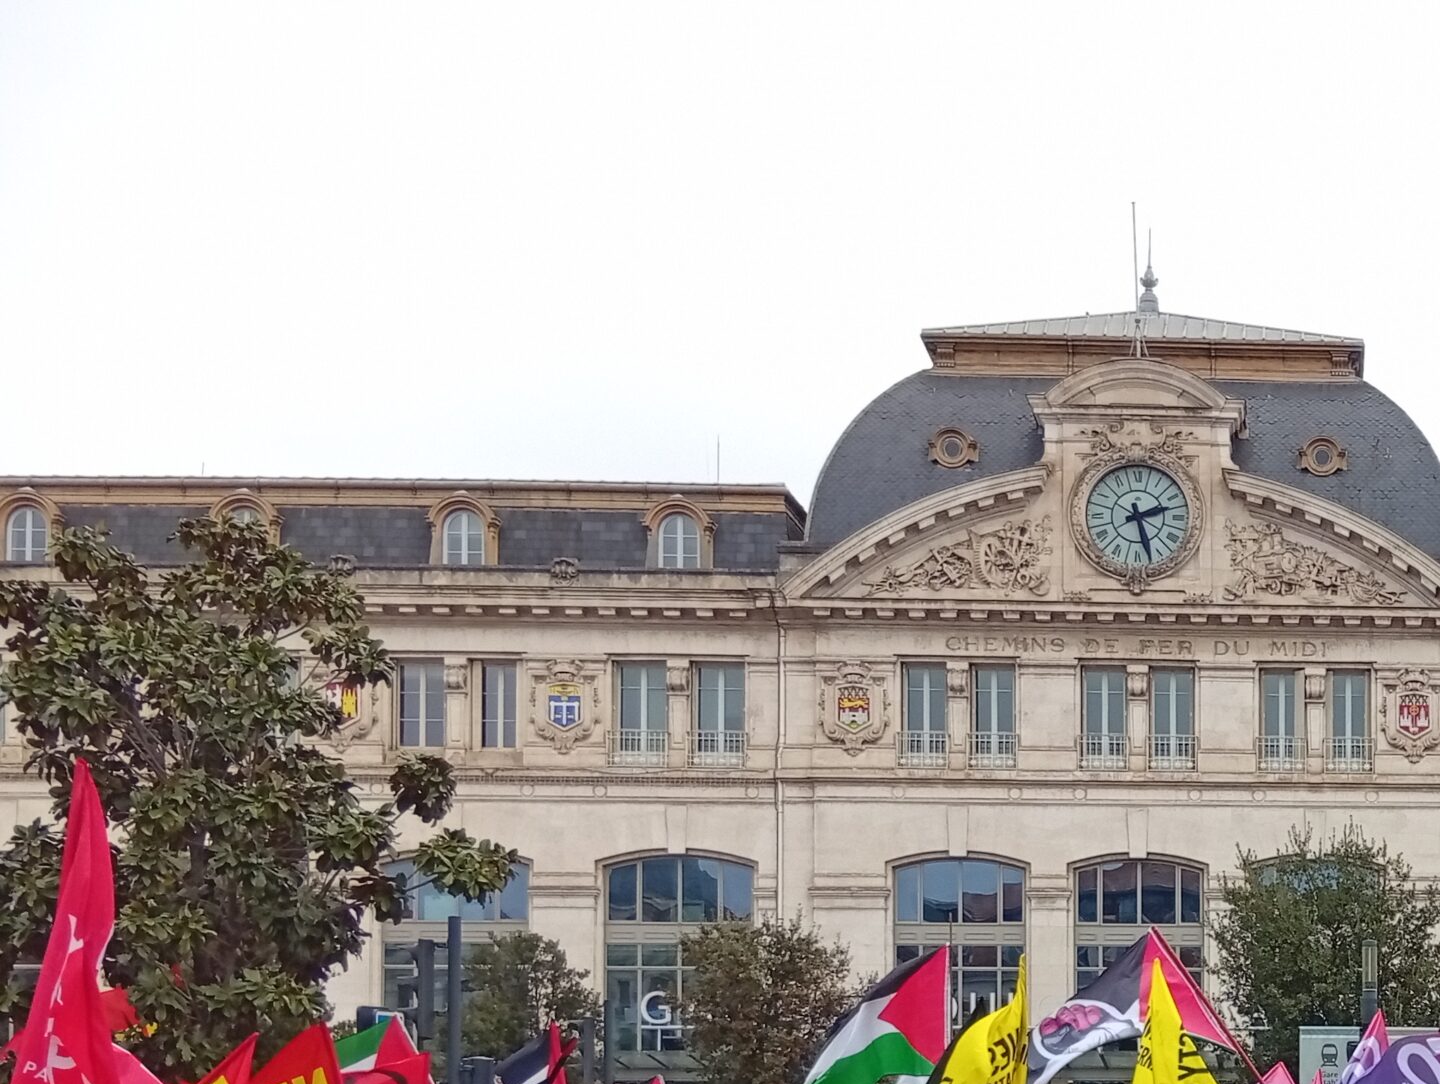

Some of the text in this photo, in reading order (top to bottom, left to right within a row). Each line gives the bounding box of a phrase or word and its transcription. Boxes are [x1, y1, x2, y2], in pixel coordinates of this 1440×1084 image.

[945, 636, 1326, 657] CHEMINS DE FER DU MIDI
